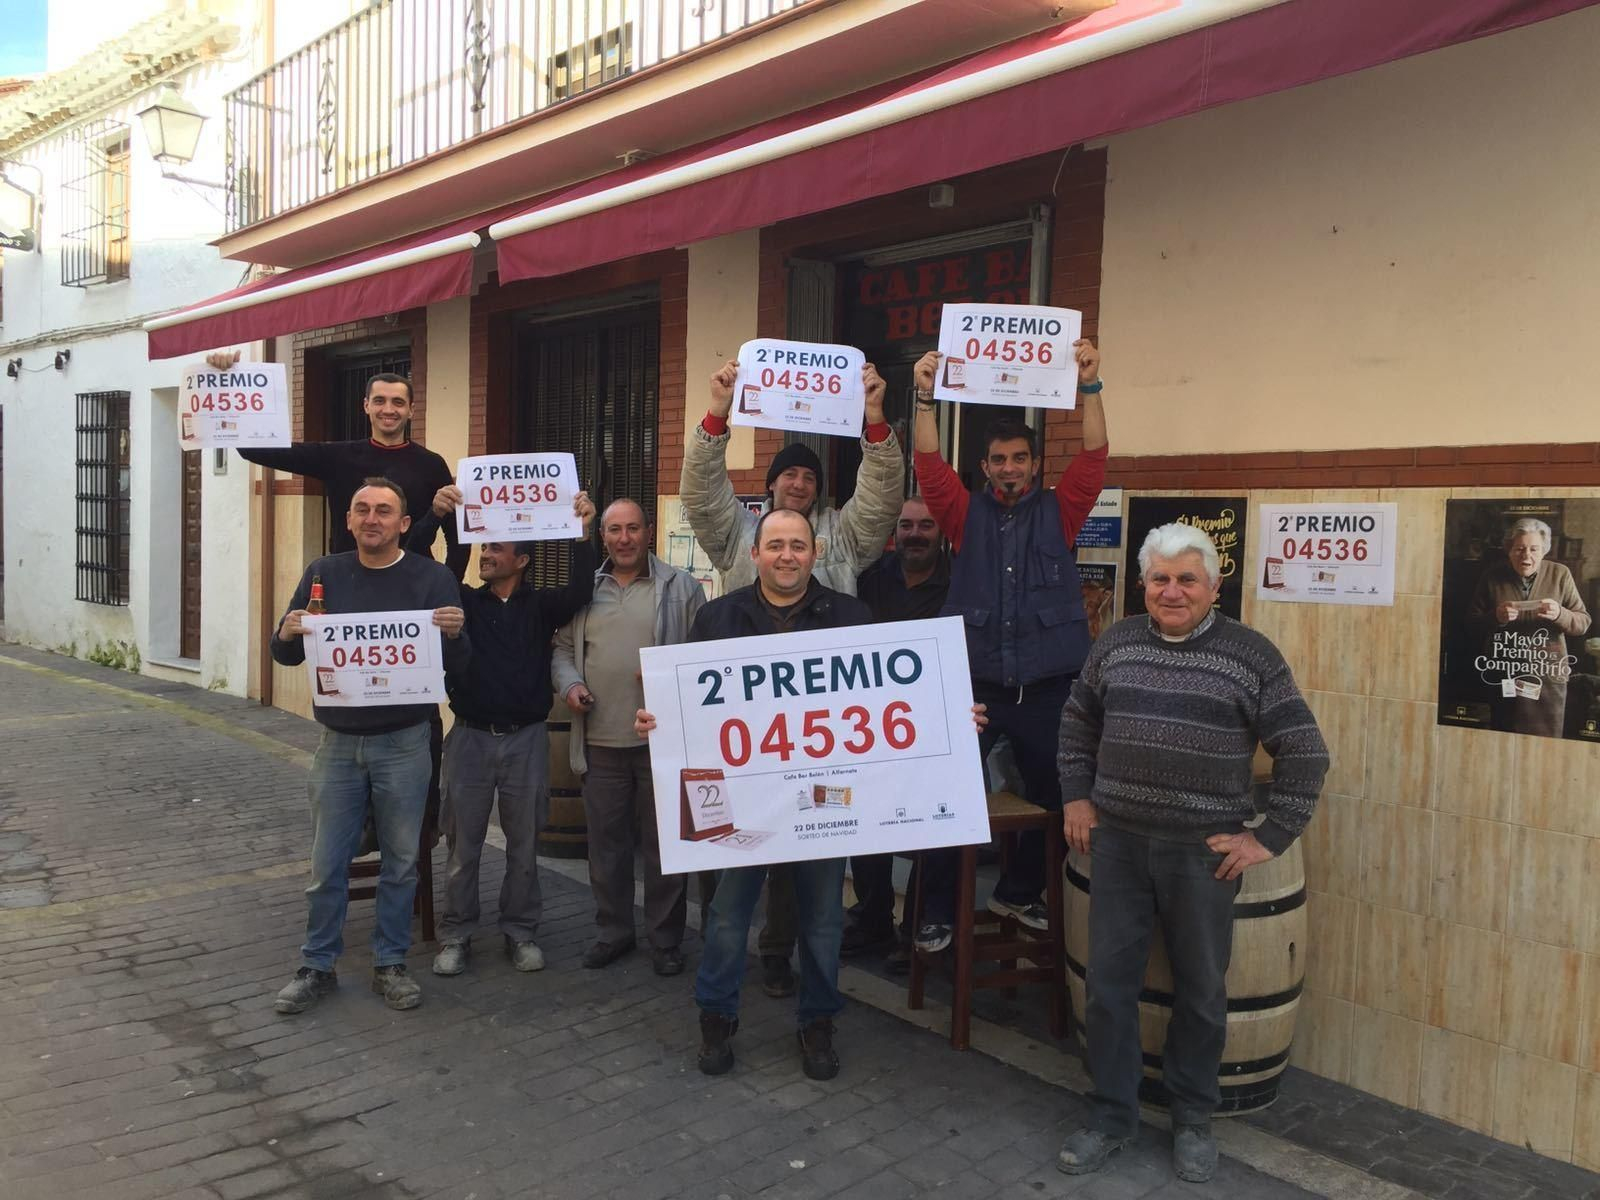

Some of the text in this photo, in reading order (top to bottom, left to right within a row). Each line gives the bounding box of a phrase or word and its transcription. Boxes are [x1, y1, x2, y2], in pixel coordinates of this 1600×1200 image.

[860, 257, 969, 305] CAFE
[962, 315, 1061, 336] 2º PREMIO
[756, 349, 848, 369] 2º PREMIO
[965, 338, 1053, 364] 04536
[197, 373, 268, 388] PREMIO
[761, 368, 842, 394] 04536
[191, 393, 264, 413] 04536
[473, 464, 561, 480] 2º PREMIO
[480, 484, 557, 505] 04536
[1192, 508, 1235, 531] Premio
[1278, 515, 1375, 533] 2º PREMIO
[1283, 538, 1368, 561] 04536
[324, 623, 420, 642] 2º PREMIO
[1504, 628, 1549, 648] Mayor
[332, 644, 416, 667] 04536
[1493, 642, 1548, 661] Premio
[697, 648, 923, 706] 2º PREMIO
[719, 701, 917, 767] 04536
[698, 785, 723, 808] 22
[794, 819, 859, 832] 22 DE DICIEMBRE
[797, 832, 821, 840] SORTEO
[830, 829, 857, 837] NAVIDAD
